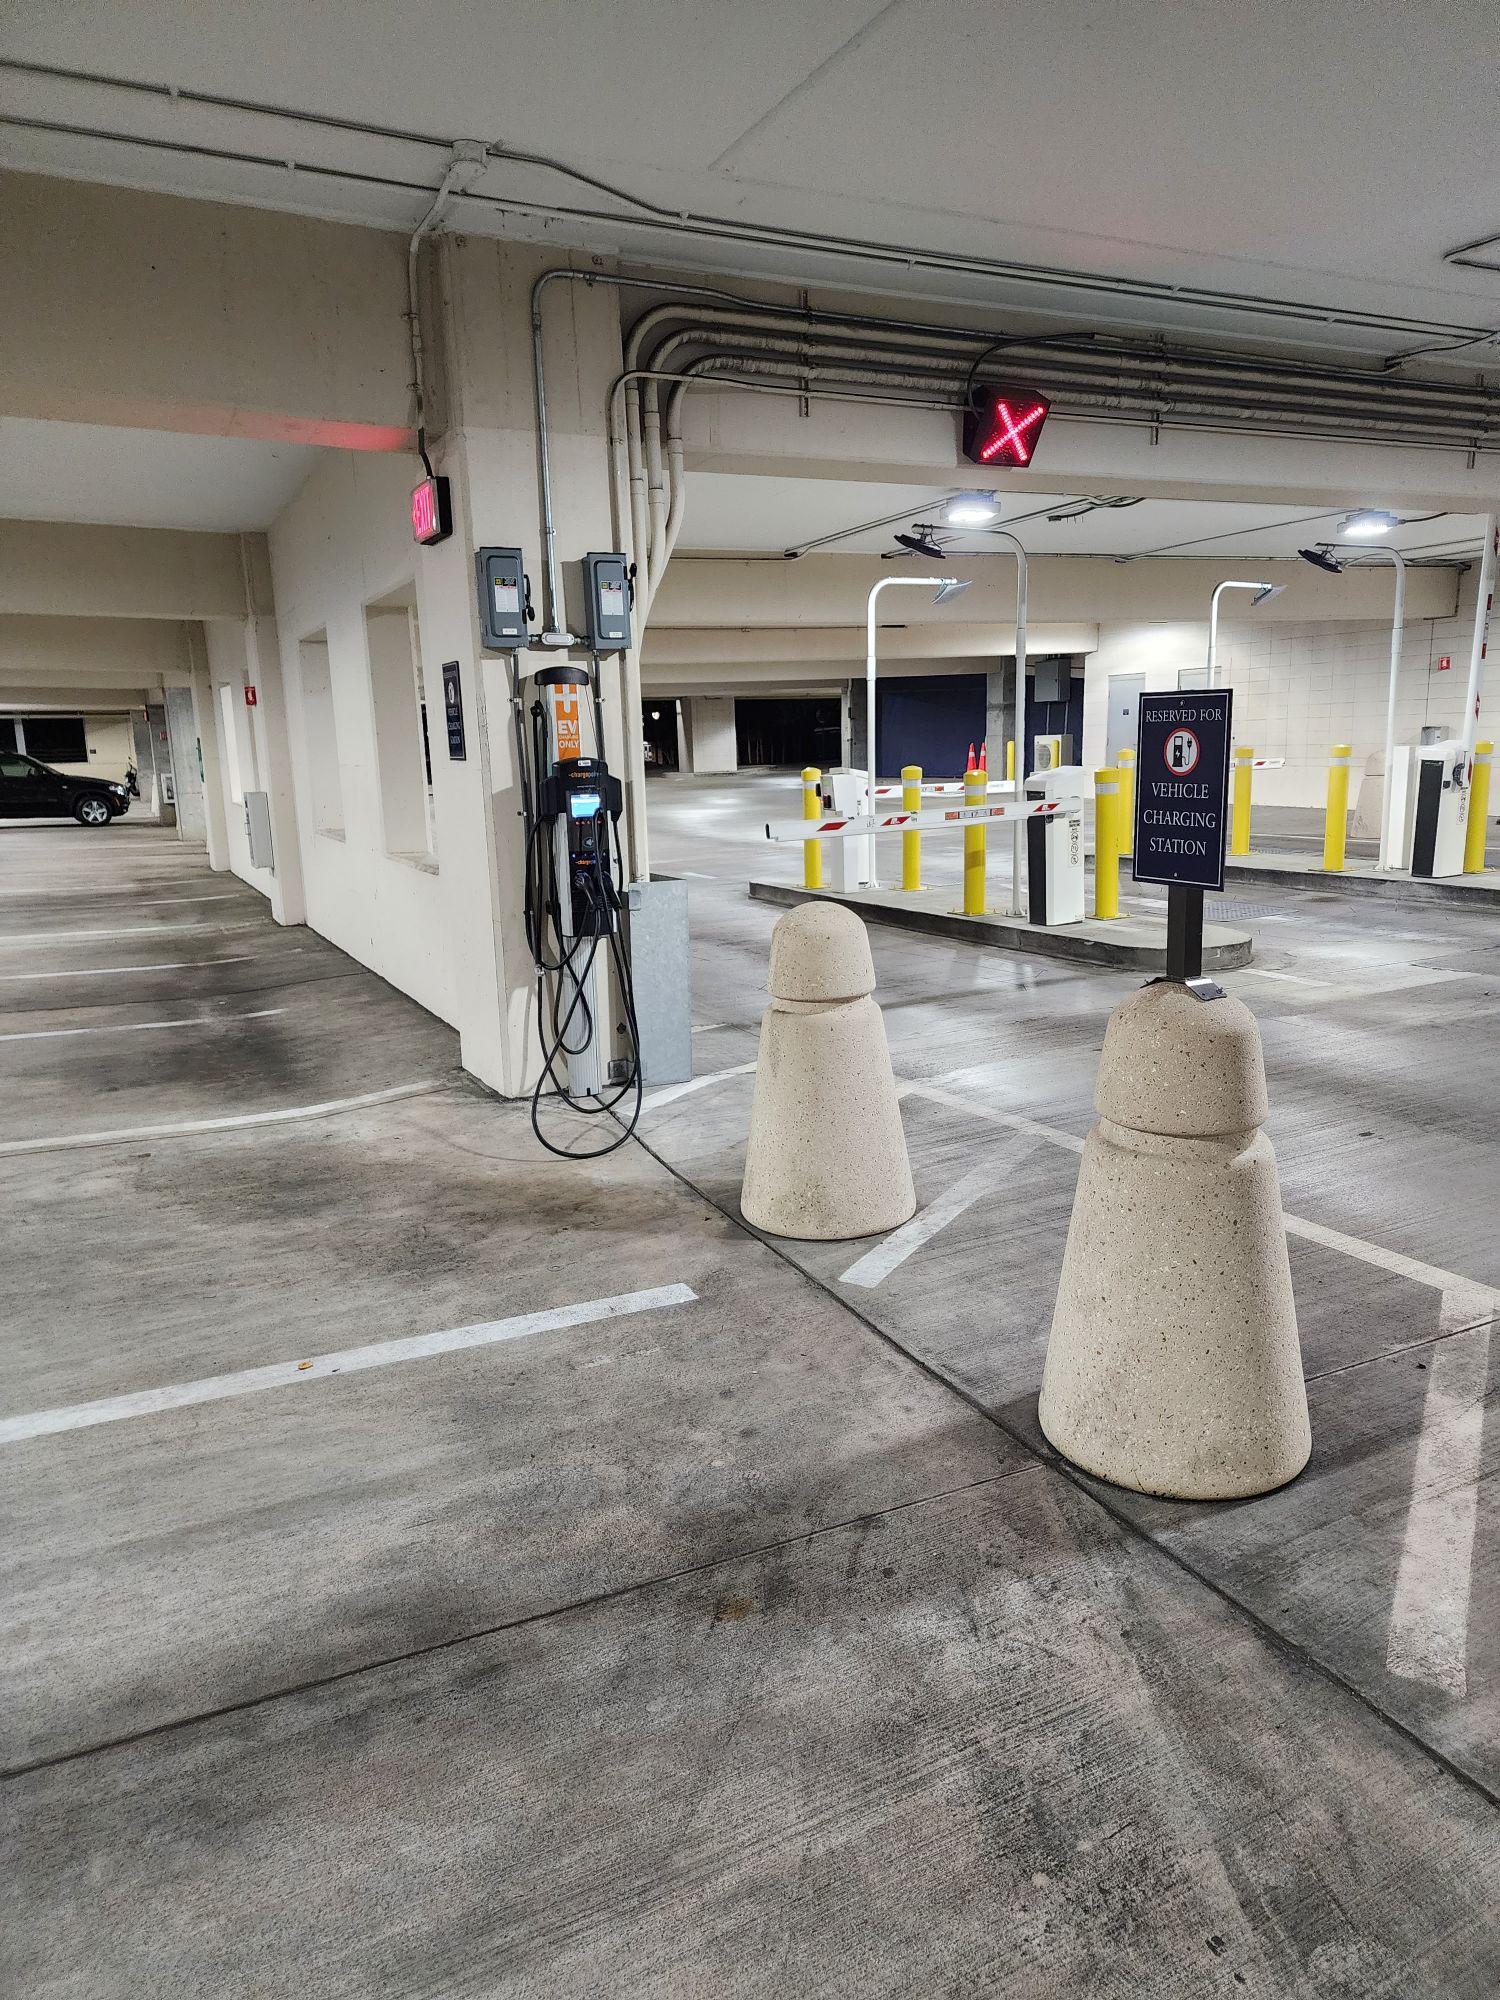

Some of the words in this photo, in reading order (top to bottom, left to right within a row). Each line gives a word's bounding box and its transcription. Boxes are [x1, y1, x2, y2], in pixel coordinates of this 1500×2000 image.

[414, 486, 432, 536] EXIT
[1145, 709, 1197, 722] RESERVED
[1200, 708, 1223, 721] FOR
[558, 720, 578, 734] EV
[558, 740, 580, 749] ONLY
[1151, 782, 1209, 799] VEHICLE
[1143, 809, 1217, 828] CHARGING
[1149, 837, 1207, 856] STATION
